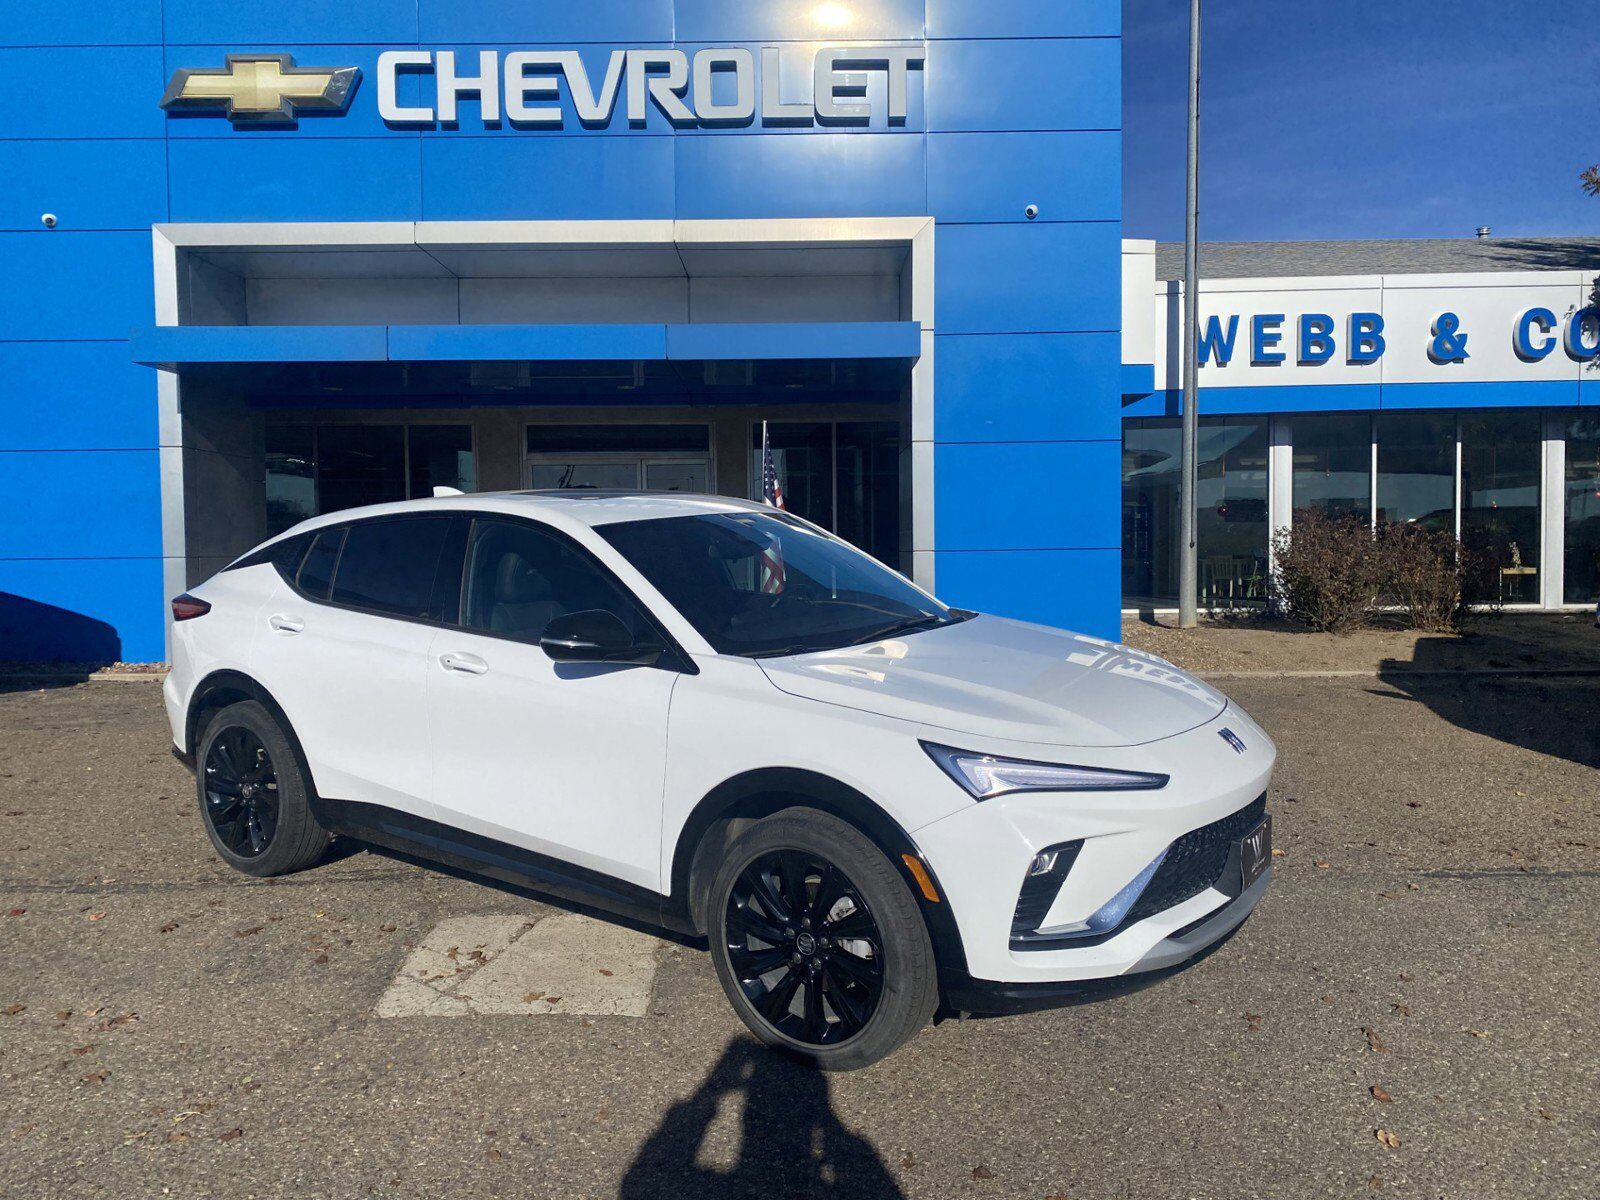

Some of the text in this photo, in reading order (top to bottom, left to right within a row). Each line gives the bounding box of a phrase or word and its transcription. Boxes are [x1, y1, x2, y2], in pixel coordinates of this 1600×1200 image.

[377, 46, 926, 129] CHEVROLET
[1198, 312, 1386, 367] WEBB
[1427, 312, 1471, 365] &
